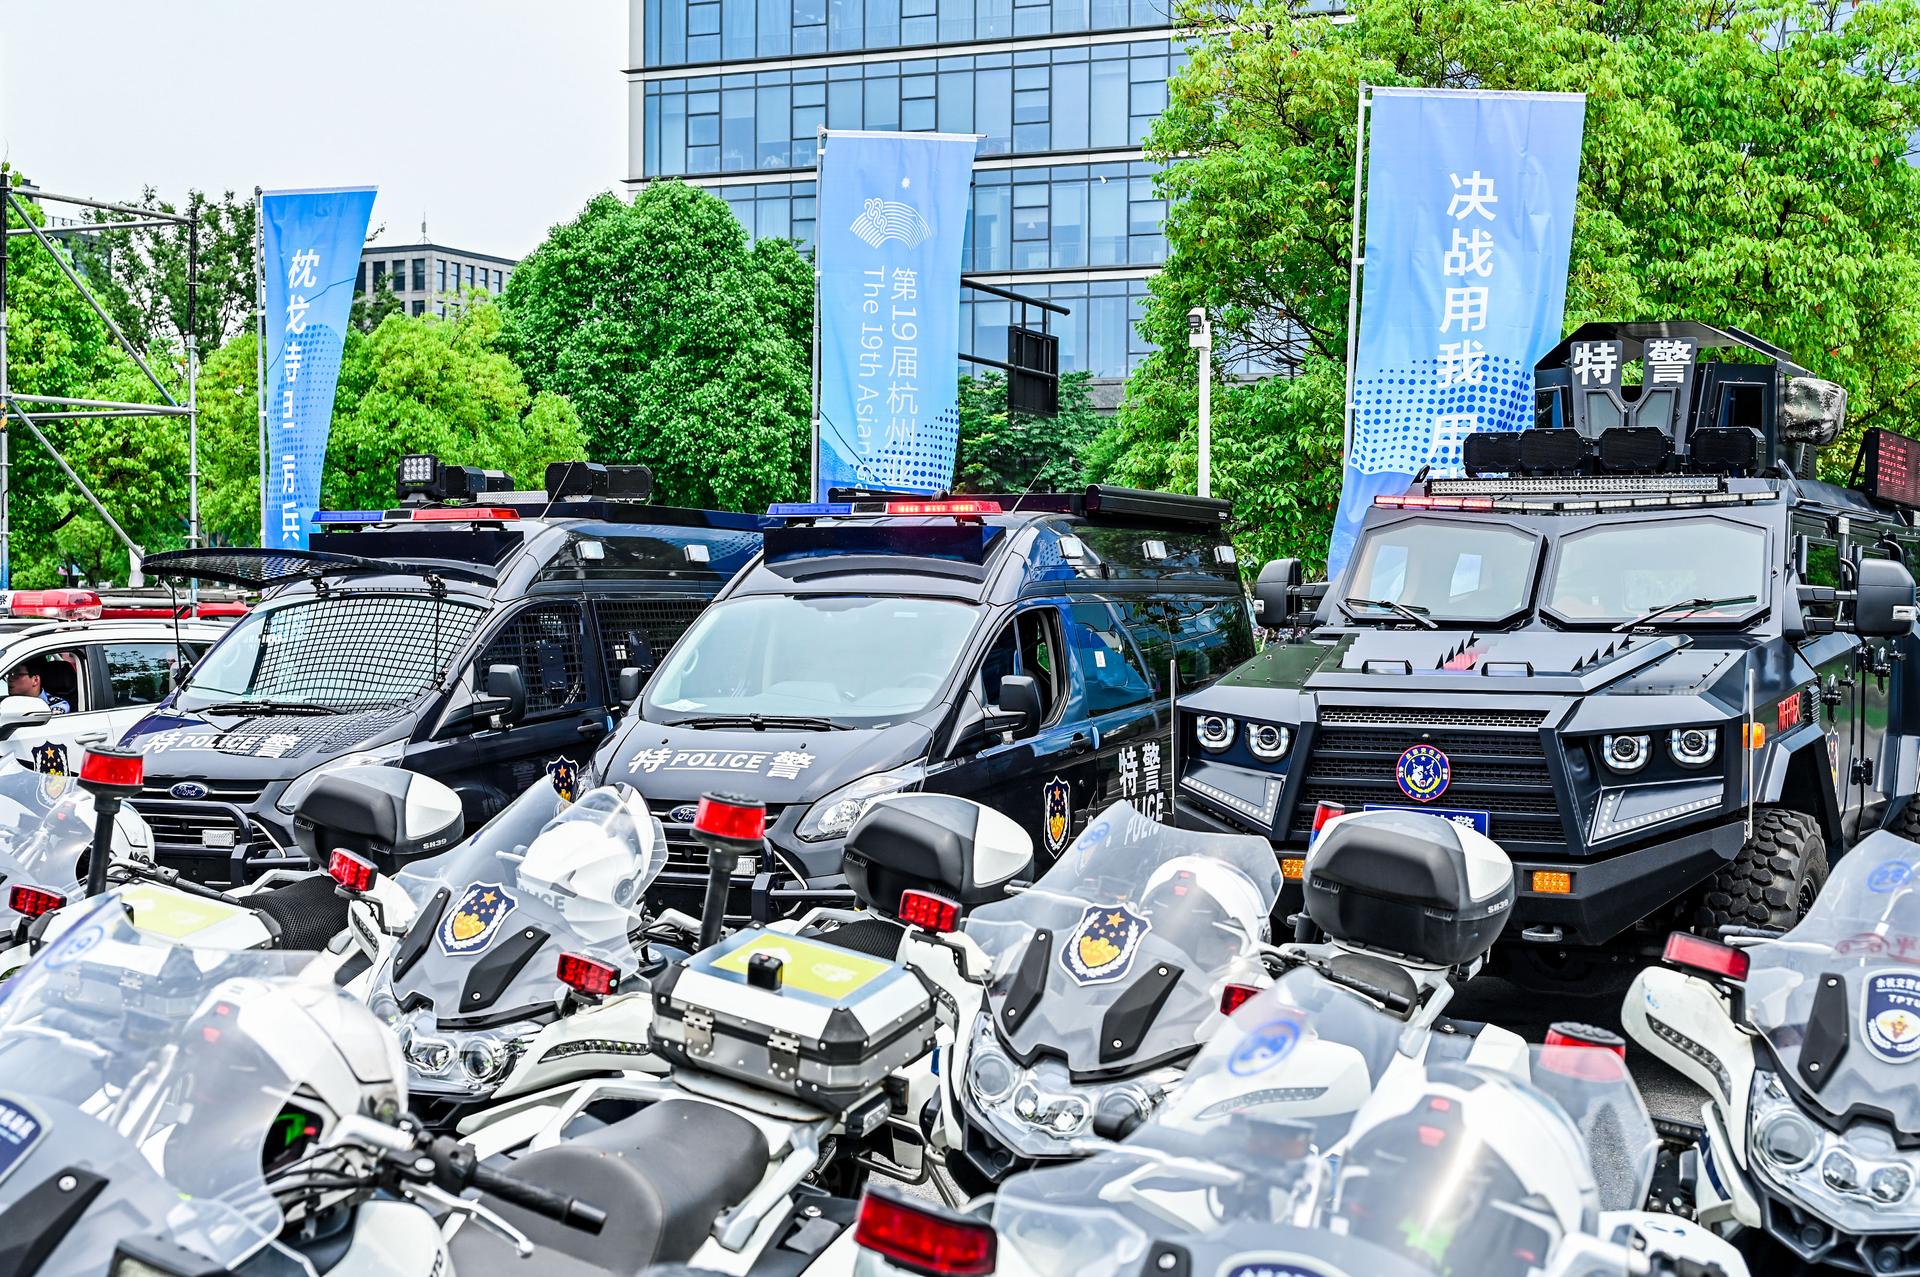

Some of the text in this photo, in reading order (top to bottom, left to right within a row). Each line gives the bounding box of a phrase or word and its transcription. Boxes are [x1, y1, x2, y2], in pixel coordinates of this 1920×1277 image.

[863, 265, 885, 314] The
[859, 322, 883, 377] 19th
[1574, 340, 1692, 386] 特警
[881, 267, 919, 490] 第19届杭州亚
[856, 384, 879, 455] Asian
[142, 731, 301, 759] 特 POLICE 警
[628, 748, 816, 780] 特 POLICE 警
[1119, 742, 1161, 798] 特警
[422, 838, 447, 849] SH39
[1487, 899, 1509, 913] SH39
